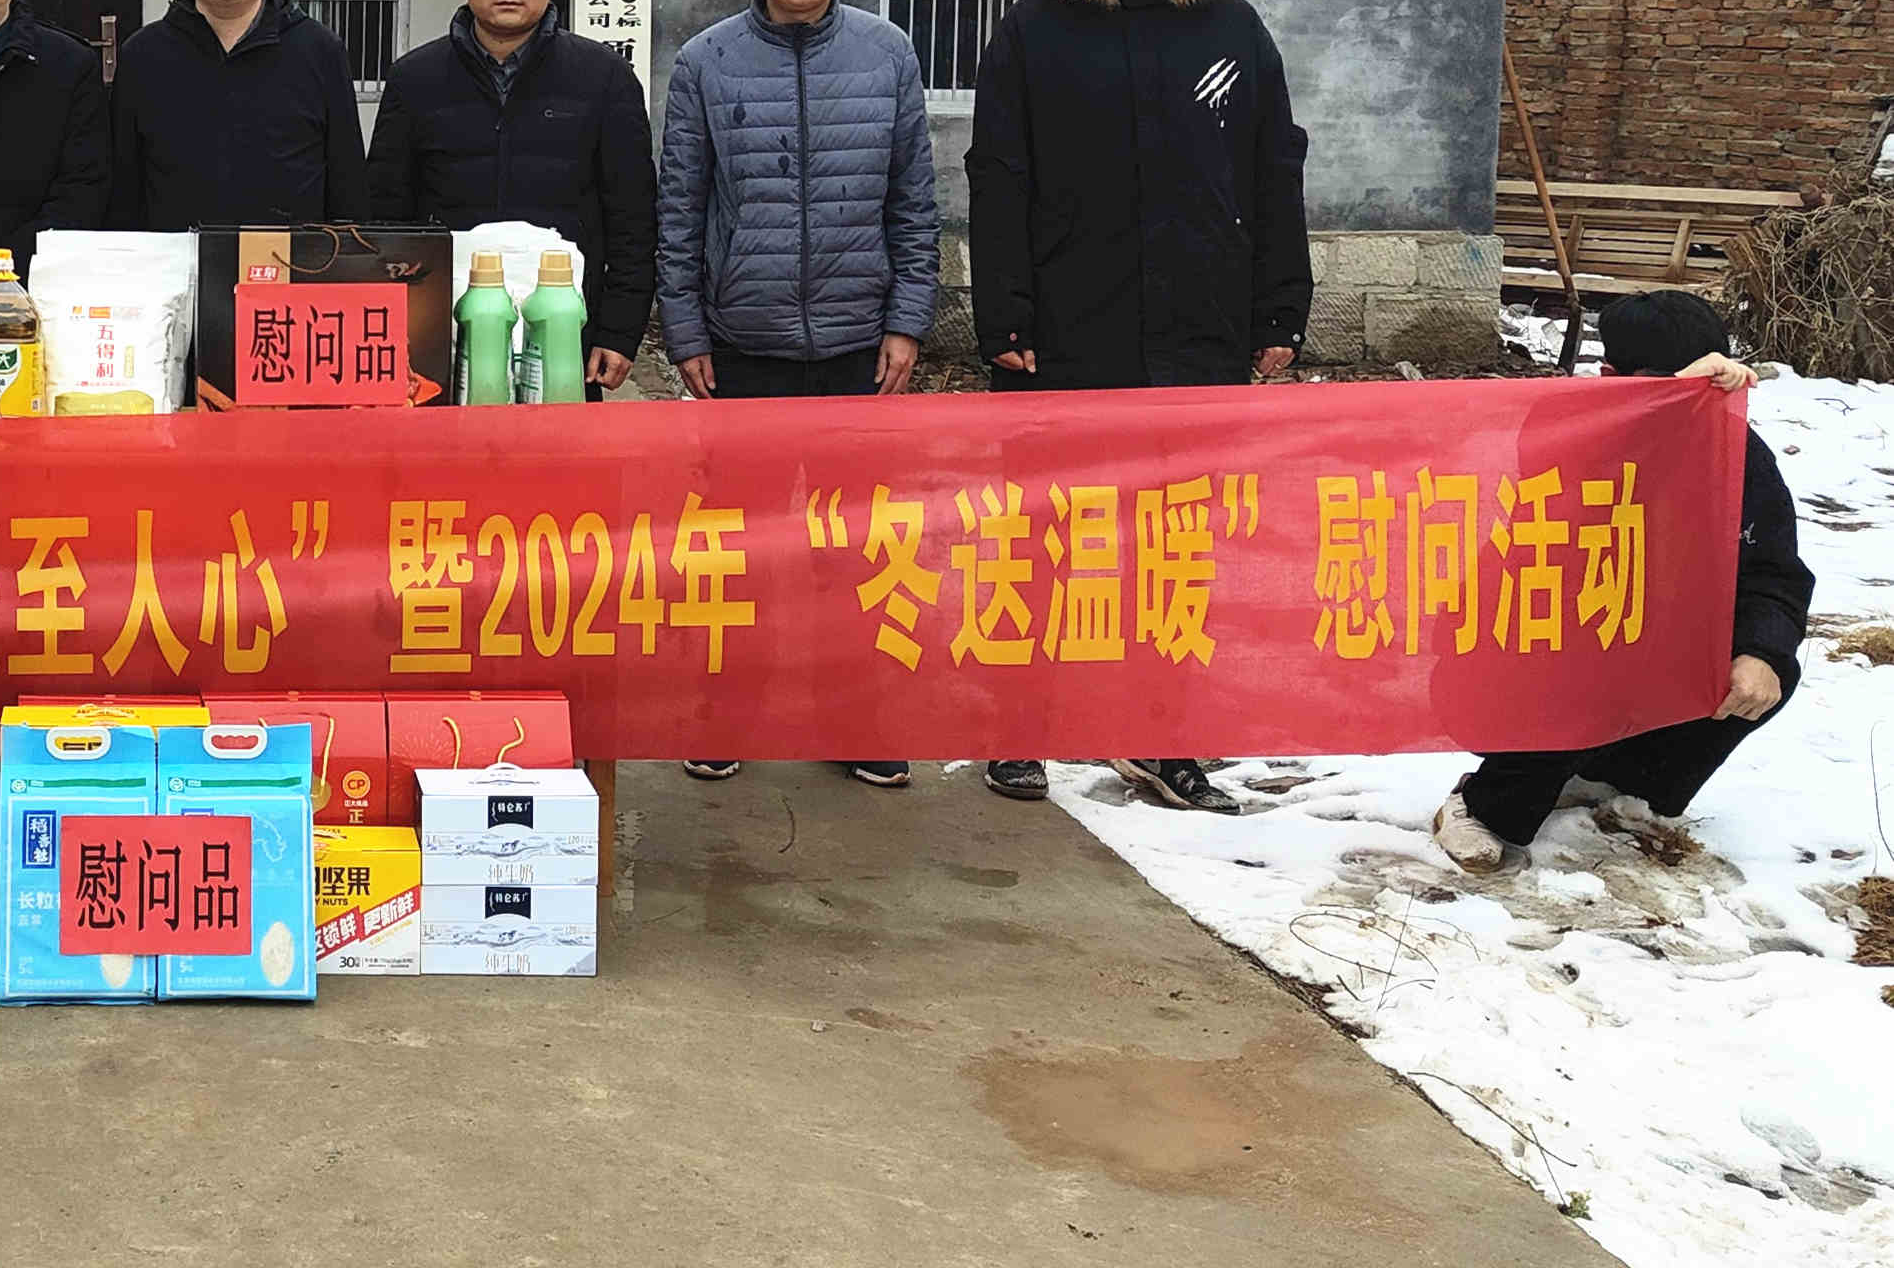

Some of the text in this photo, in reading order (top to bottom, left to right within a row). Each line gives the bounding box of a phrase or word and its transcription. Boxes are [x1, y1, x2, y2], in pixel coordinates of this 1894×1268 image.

[96, 324, 115, 379] 五得利
[250, 305, 397, 384] 慰问品
[347, 778, 366, 791] CP
[75, 840, 240, 933] 慰问品
[314, 866, 371, 897] 坚果
[322, 897, 349, 906] NUTS
